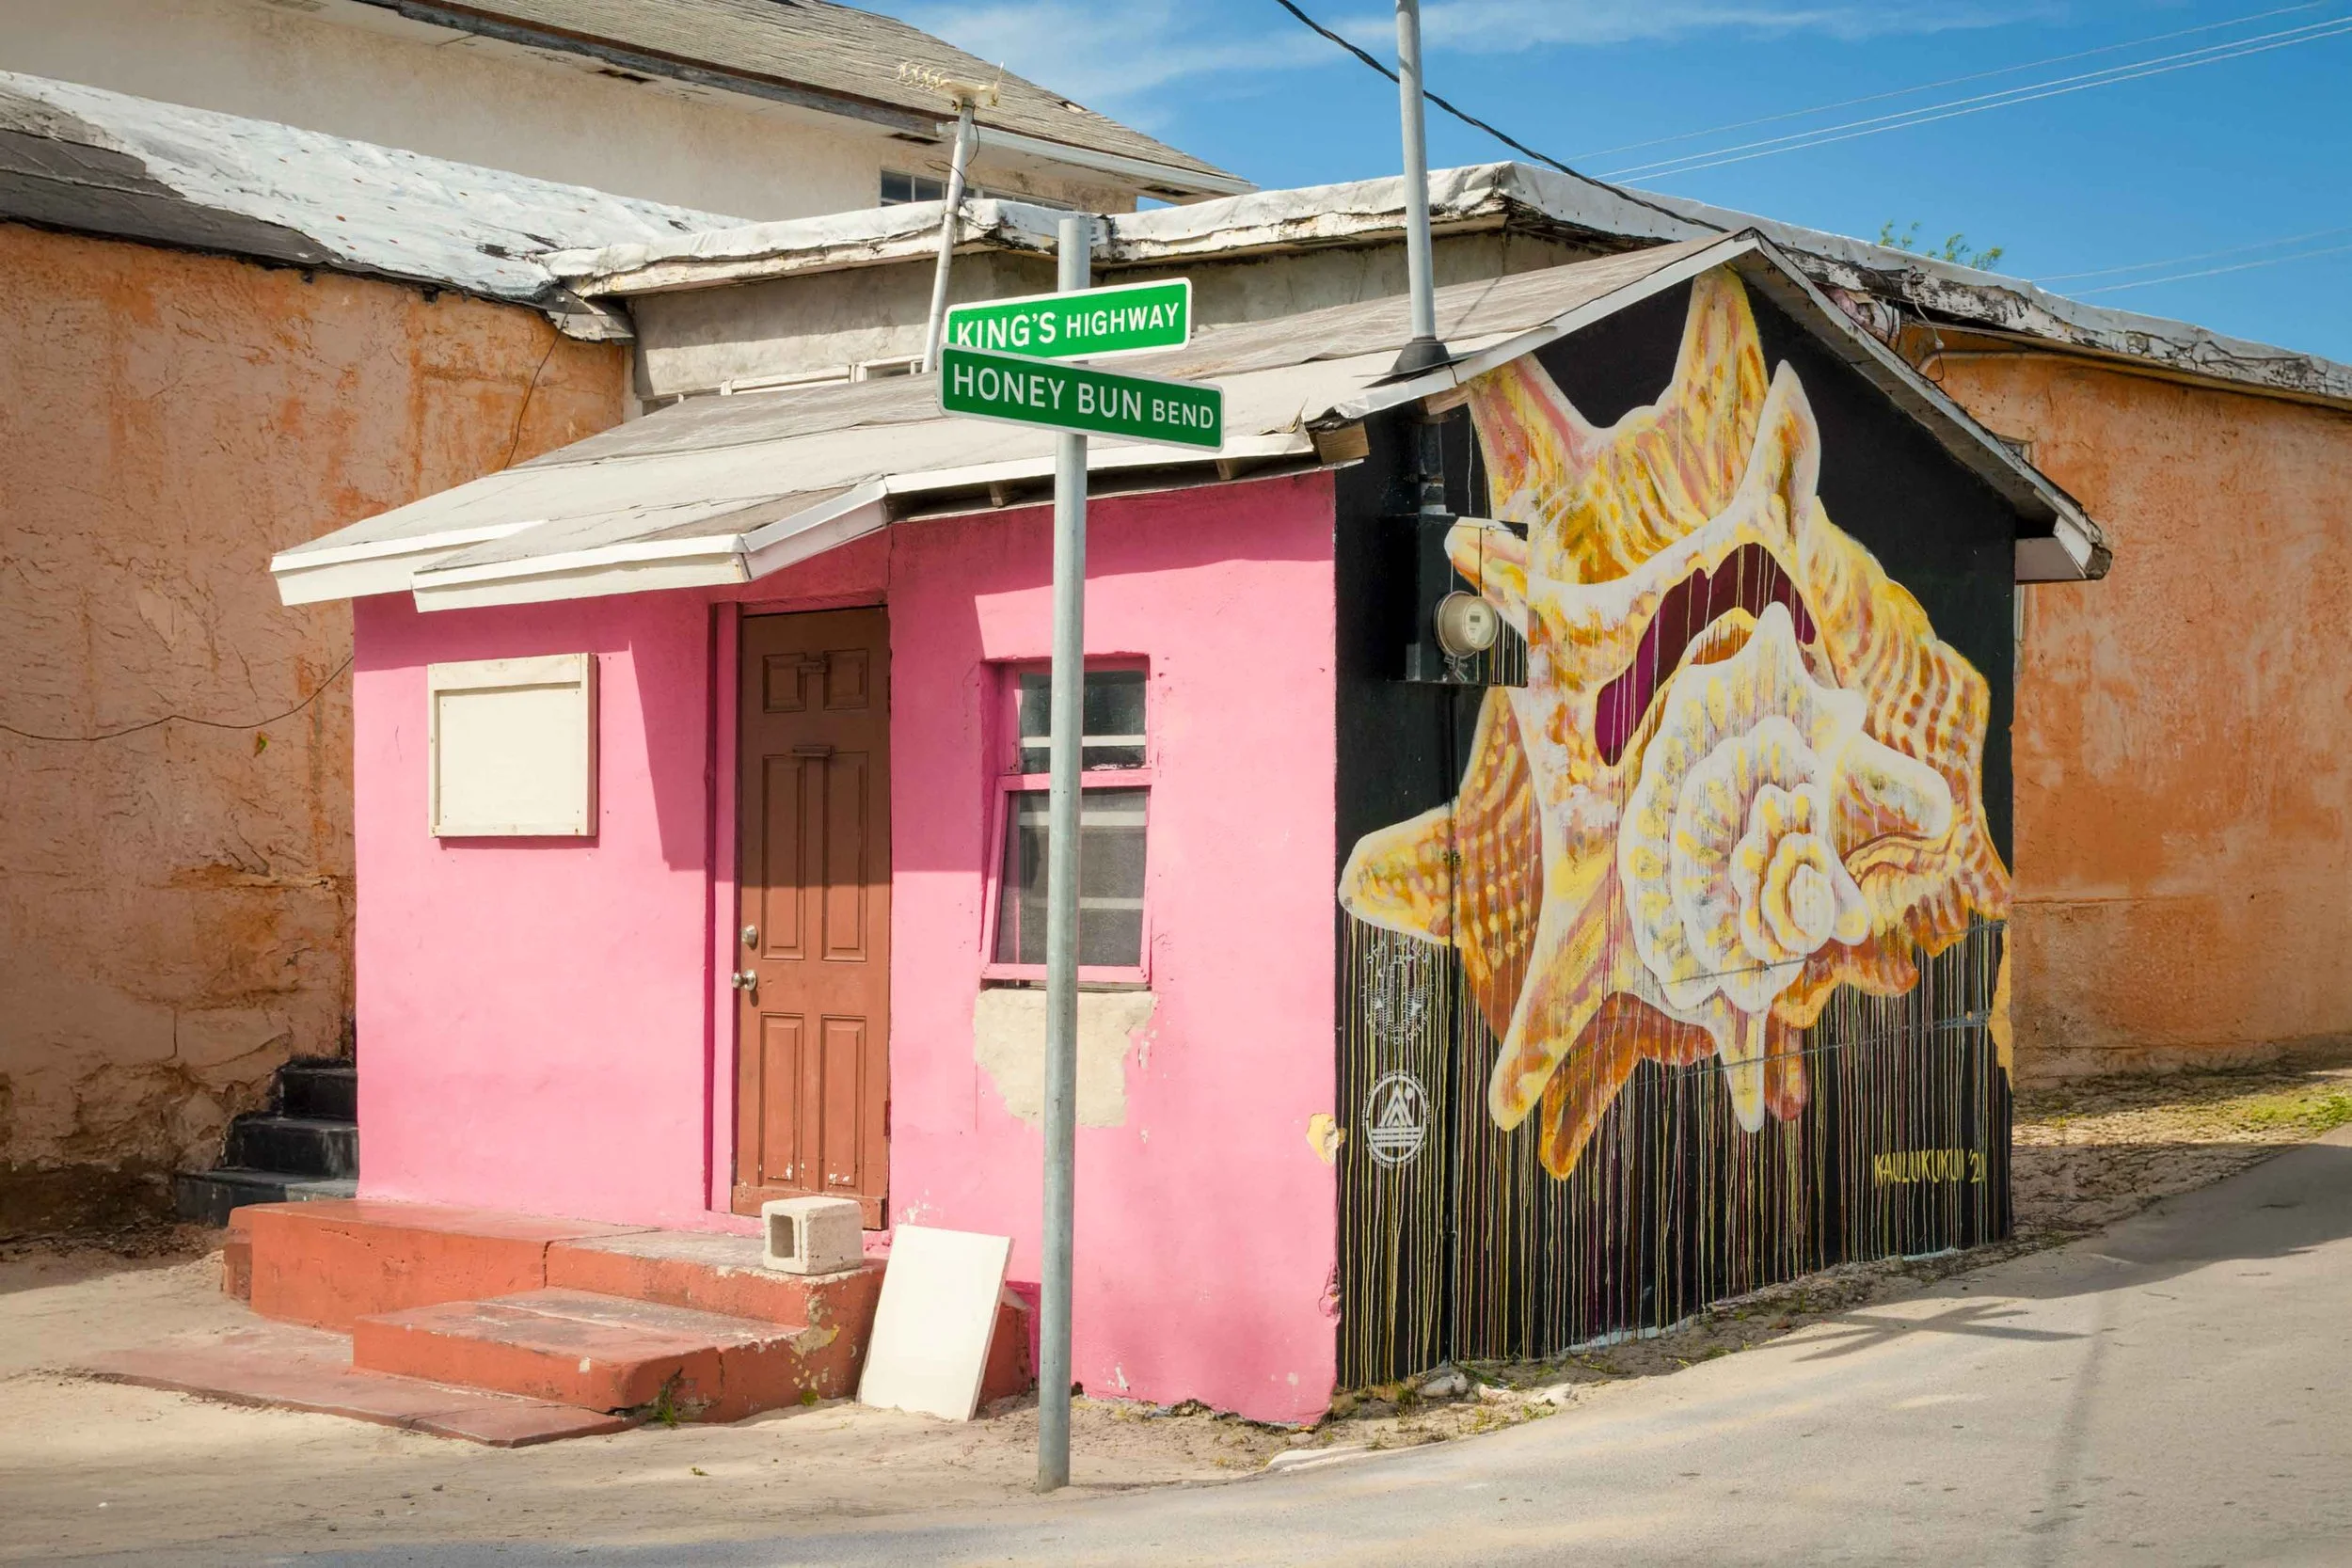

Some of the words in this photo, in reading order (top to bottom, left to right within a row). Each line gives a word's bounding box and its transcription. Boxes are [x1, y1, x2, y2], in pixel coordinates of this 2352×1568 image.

[957, 311, 1057, 348] KING'S
[1066, 302, 1180, 339] HIGHWAY
[953, 363, 1066, 410] HONEY
[1077, 382, 1142, 421] BUN
[1152, 399, 1215, 430] BEND
